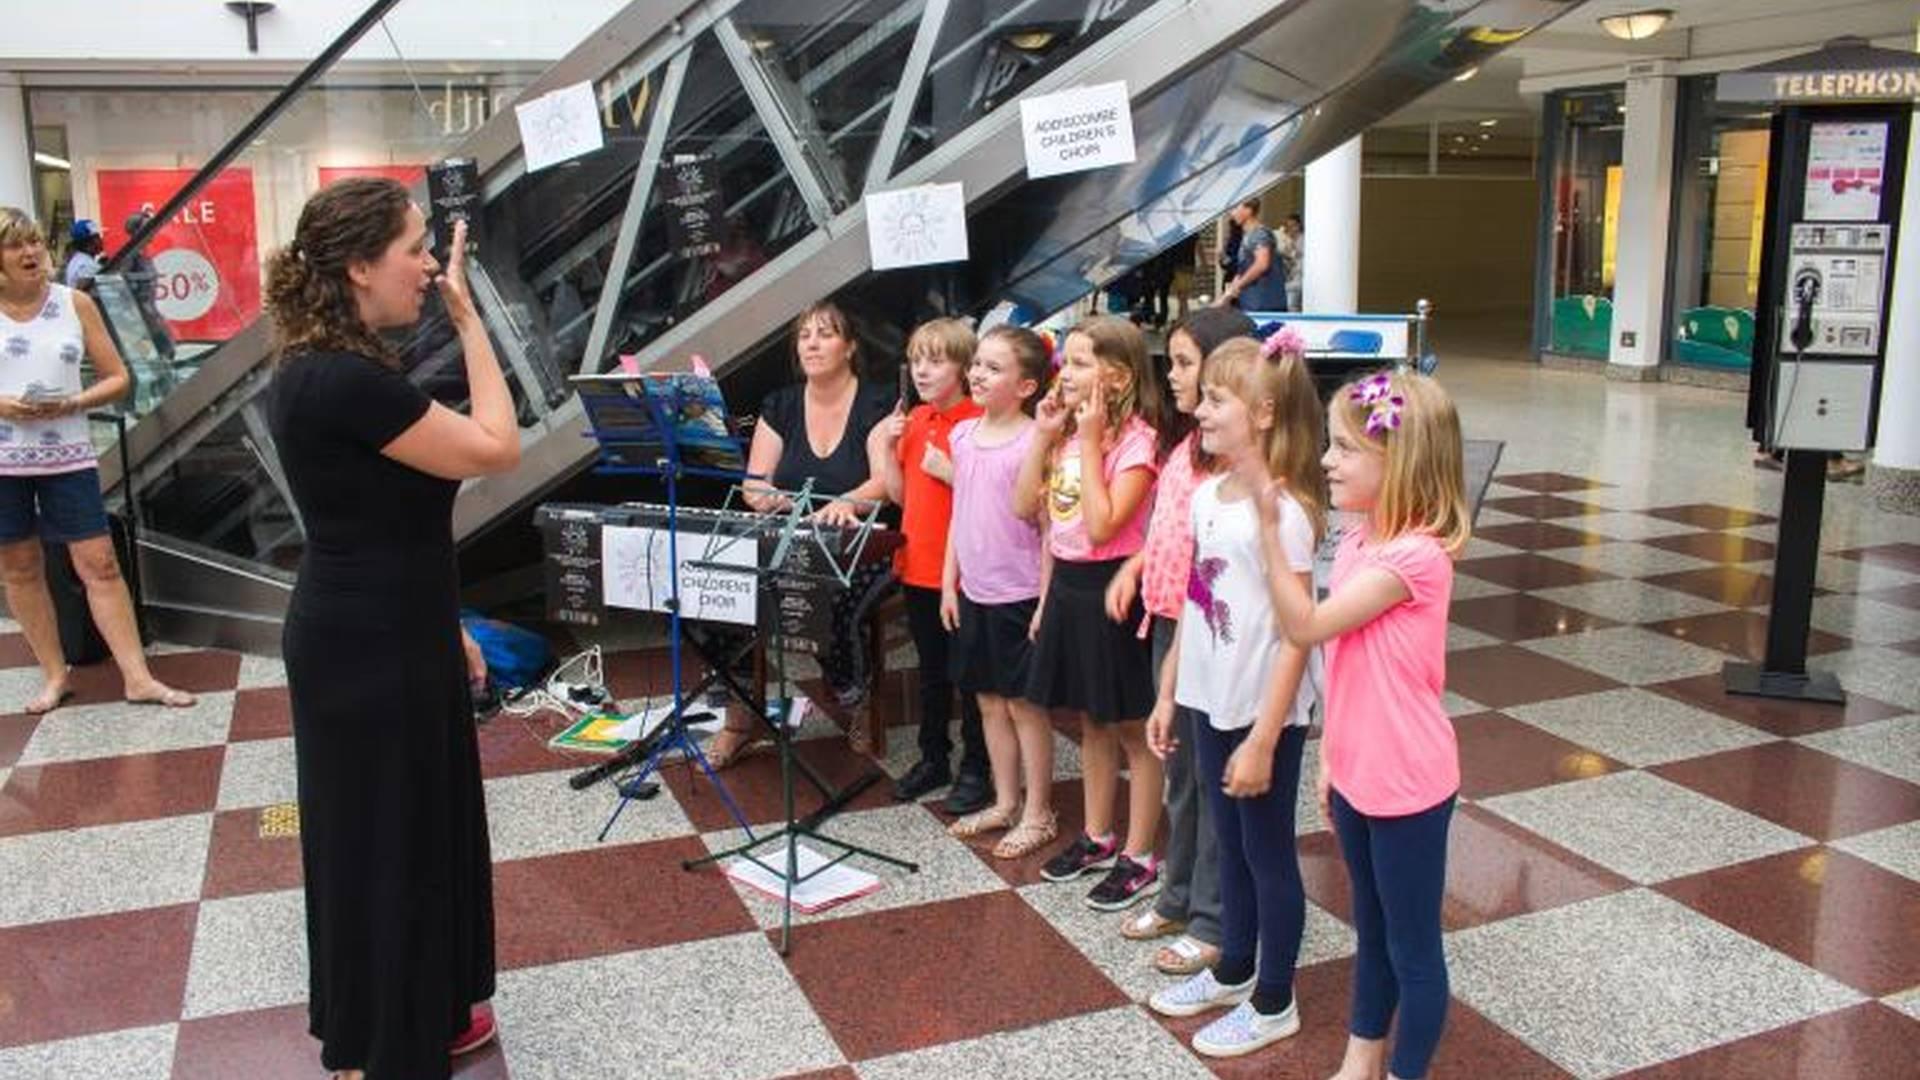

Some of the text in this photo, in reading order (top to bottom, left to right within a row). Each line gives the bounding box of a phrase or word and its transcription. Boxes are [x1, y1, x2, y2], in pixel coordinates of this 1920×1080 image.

[1060, 142, 1101, 160] CHOIR
[141, 202, 216, 224] SLE
[699, 593, 737, 609] CHOIR
